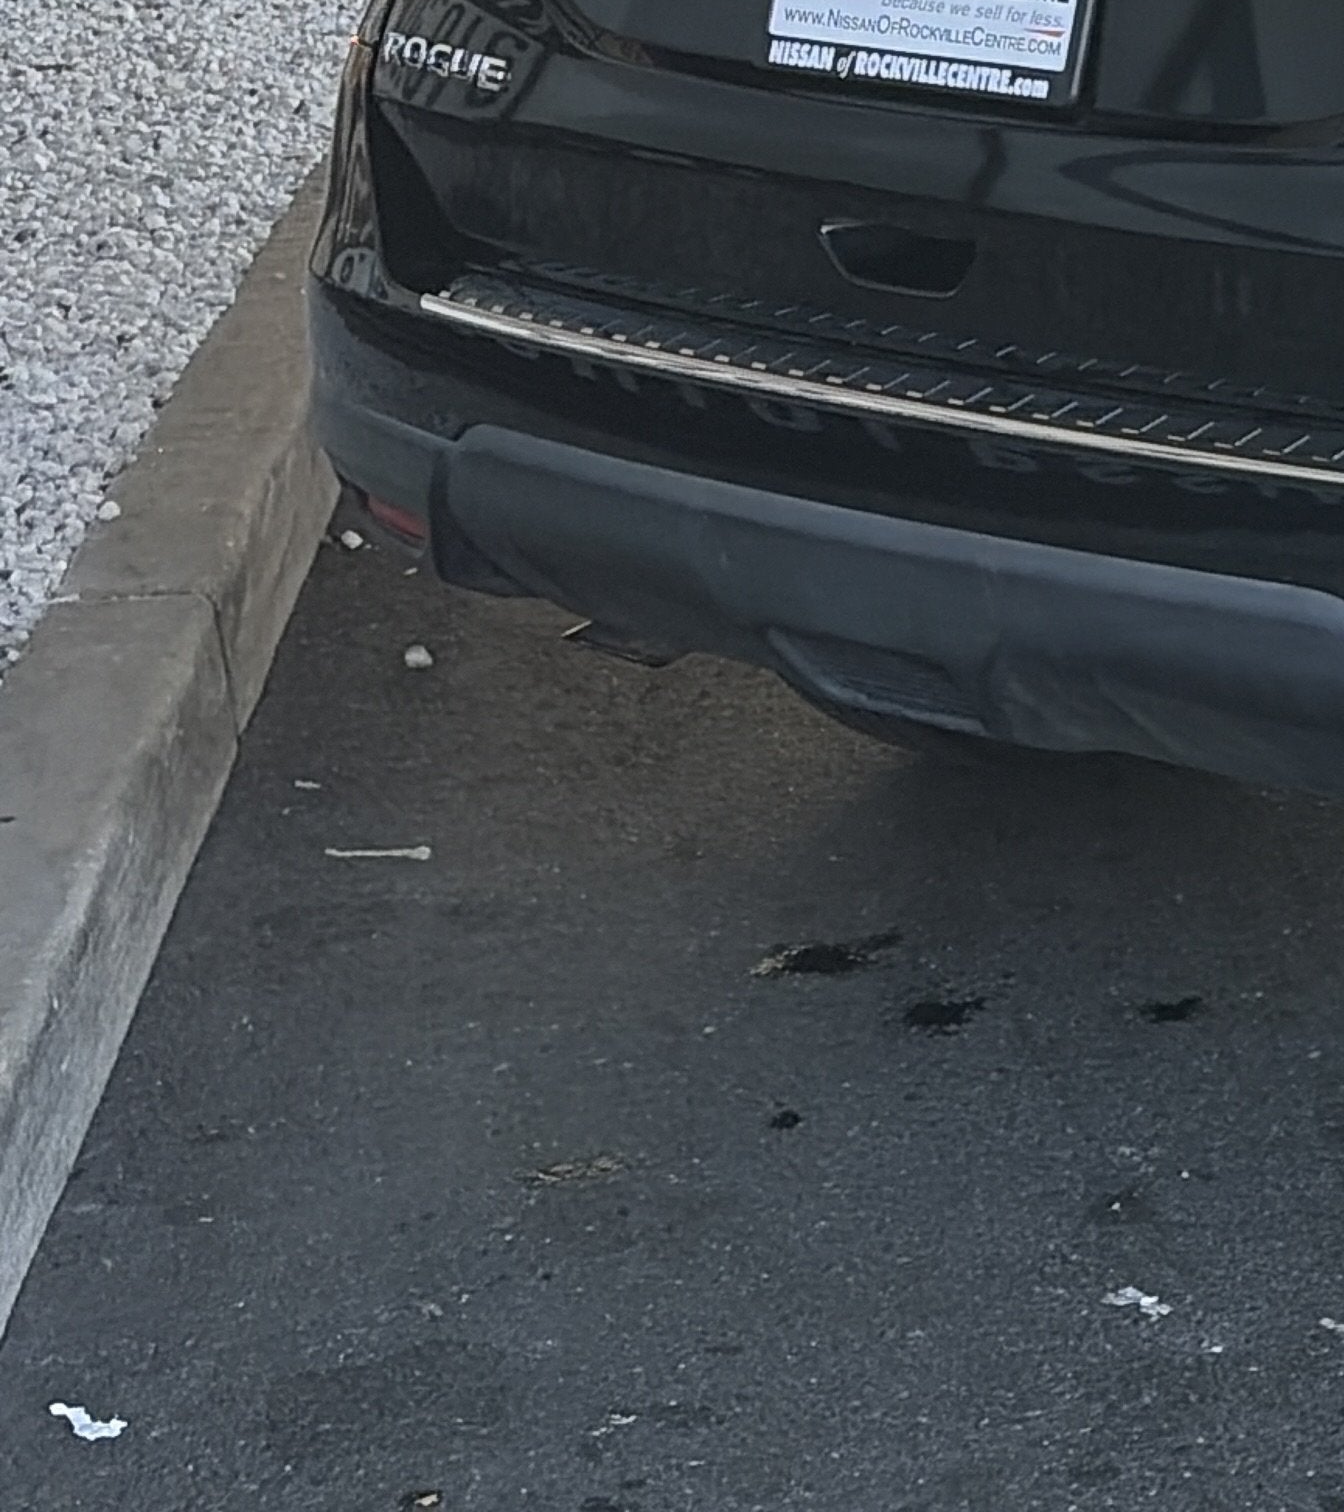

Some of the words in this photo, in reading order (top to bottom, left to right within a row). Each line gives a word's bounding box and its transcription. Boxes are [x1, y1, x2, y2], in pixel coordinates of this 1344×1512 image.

[949, 2, 971, 17] we
[973, 3, 1003, 20] sell
[1005, 5, 1030, 23] for
[383, 31, 508, 92] ROGUE
[768, 39, 837, 73] NISSAN
[836, 50, 857, 80] of
[853, 50, 1049, 99] ROCKVILLECENTRE.com
